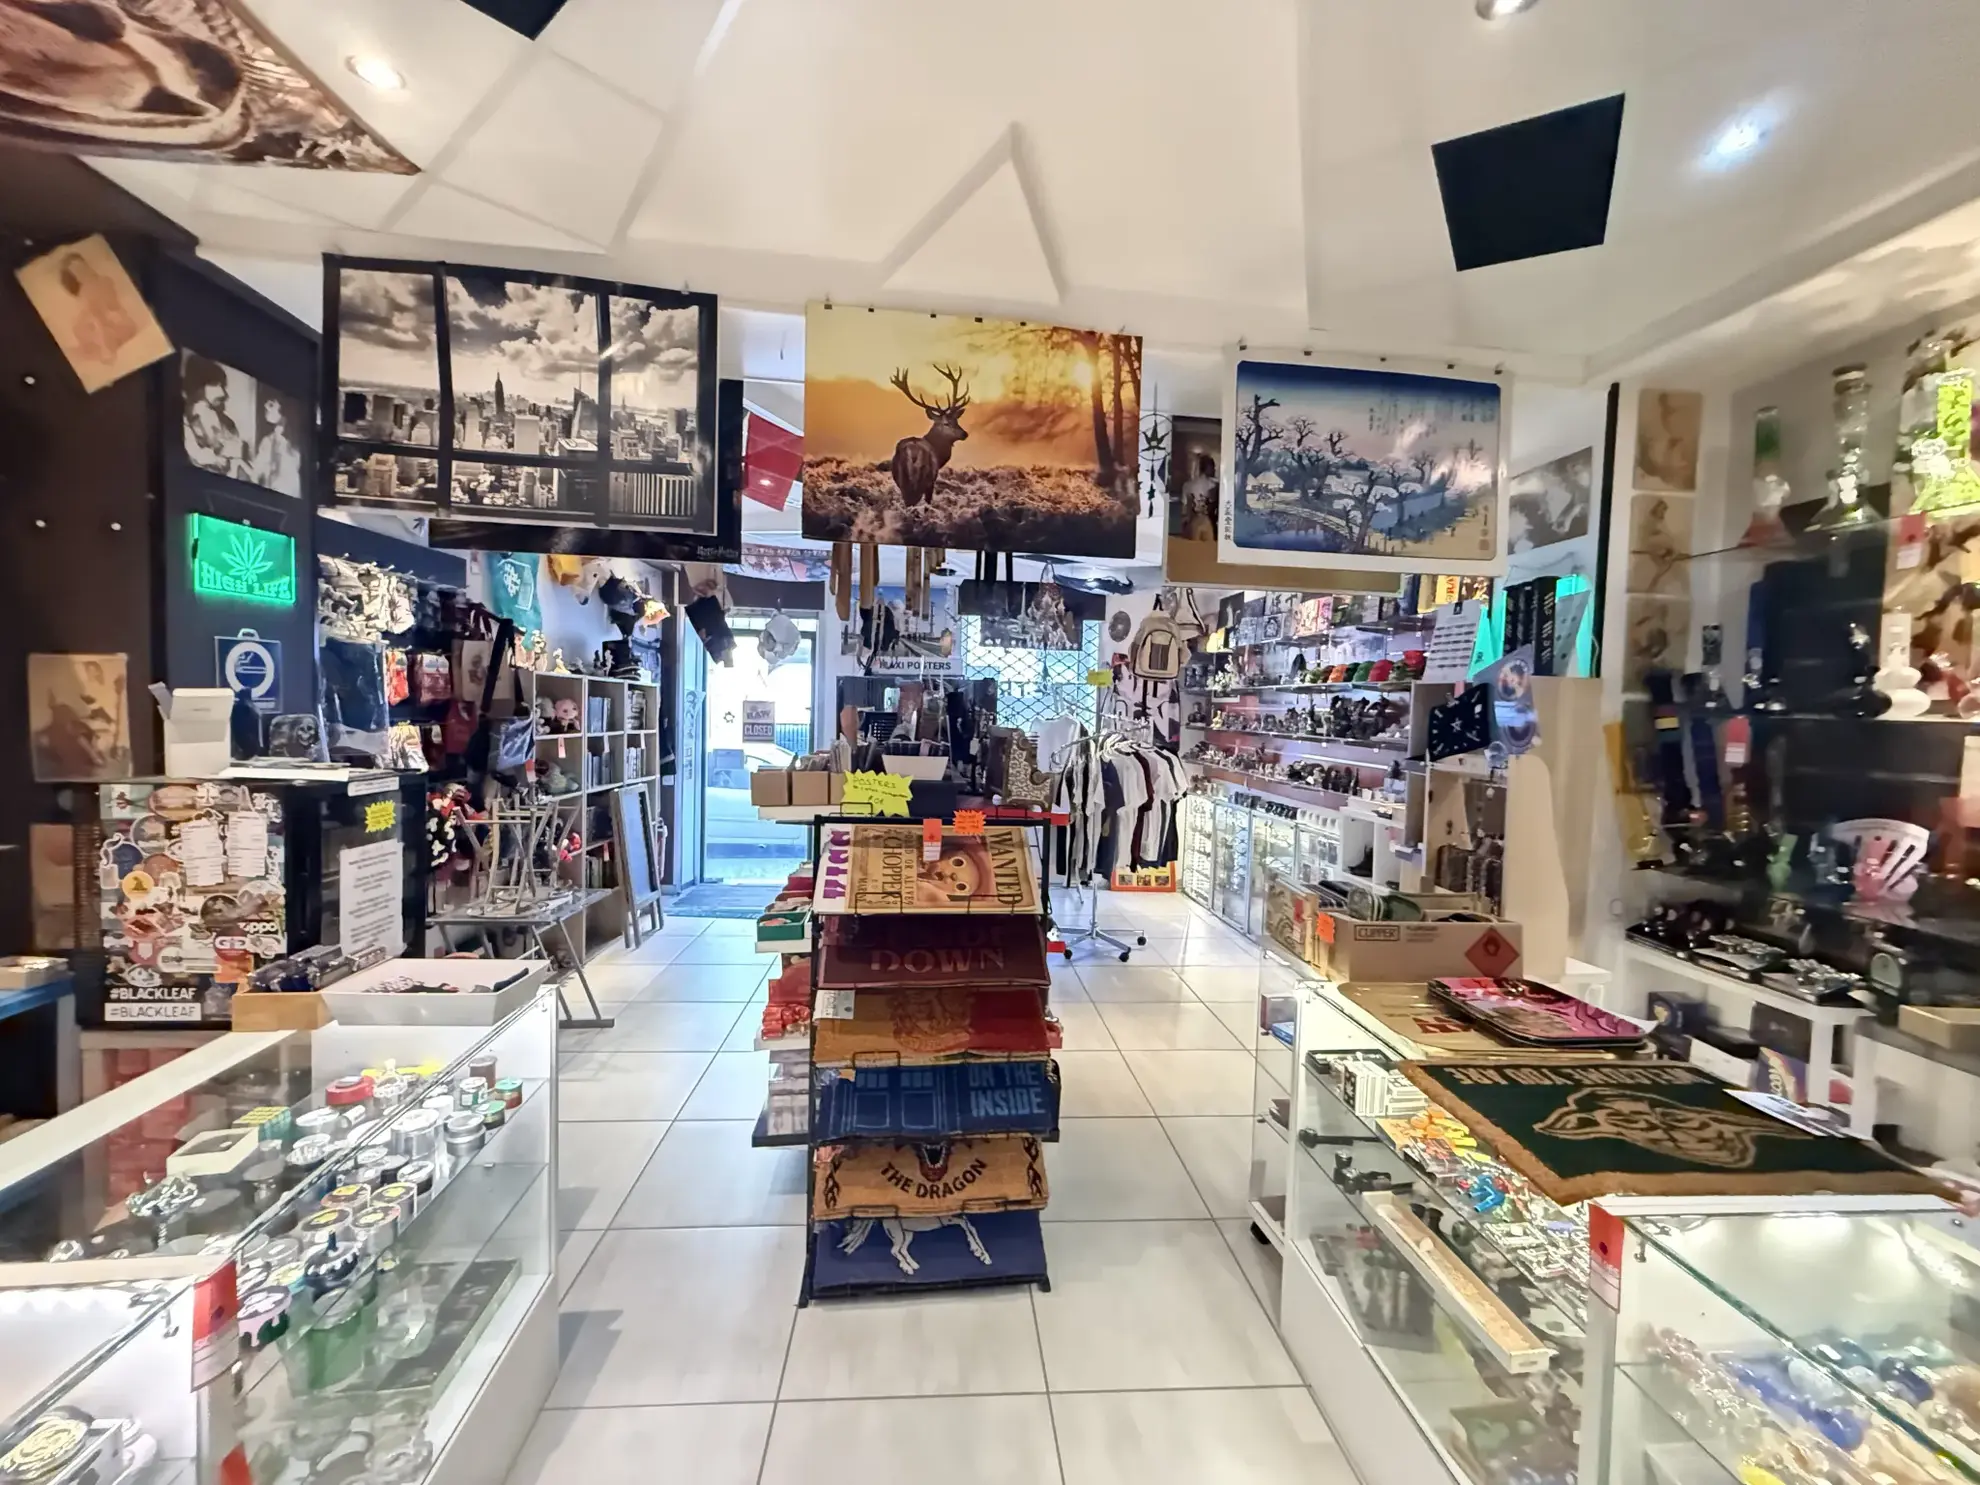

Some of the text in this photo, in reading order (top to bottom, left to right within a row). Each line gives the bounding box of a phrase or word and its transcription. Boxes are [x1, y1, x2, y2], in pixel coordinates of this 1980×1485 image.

[201, 561, 291, 599] HIGH LIFE
[744, 724, 772, 736] CLOSED
[852, 776, 896, 789] POSTERS
[882, 836, 902, 900] CHOPPER
[905, 859, 914, 870] OR
[988, 829, 1023, 905] WANTED
[1358, 927, 1396, 938] CLIPPER
[869, 948, 1005, 974] DOWN
[109, 987, 198, 1000] #BLACKLEAF
[110, 1006, 196, 1018] #BLACKLEAF
[1000, 1062, 1041, 1086] THE
[1443, 1067, 1508, 1085] ARE
[1503, 1067, 1574, 1085] YOU
[970, 1087, 1047, 1117] INSIDE
[881, 1158, 988, 1199] THE DRAGON
